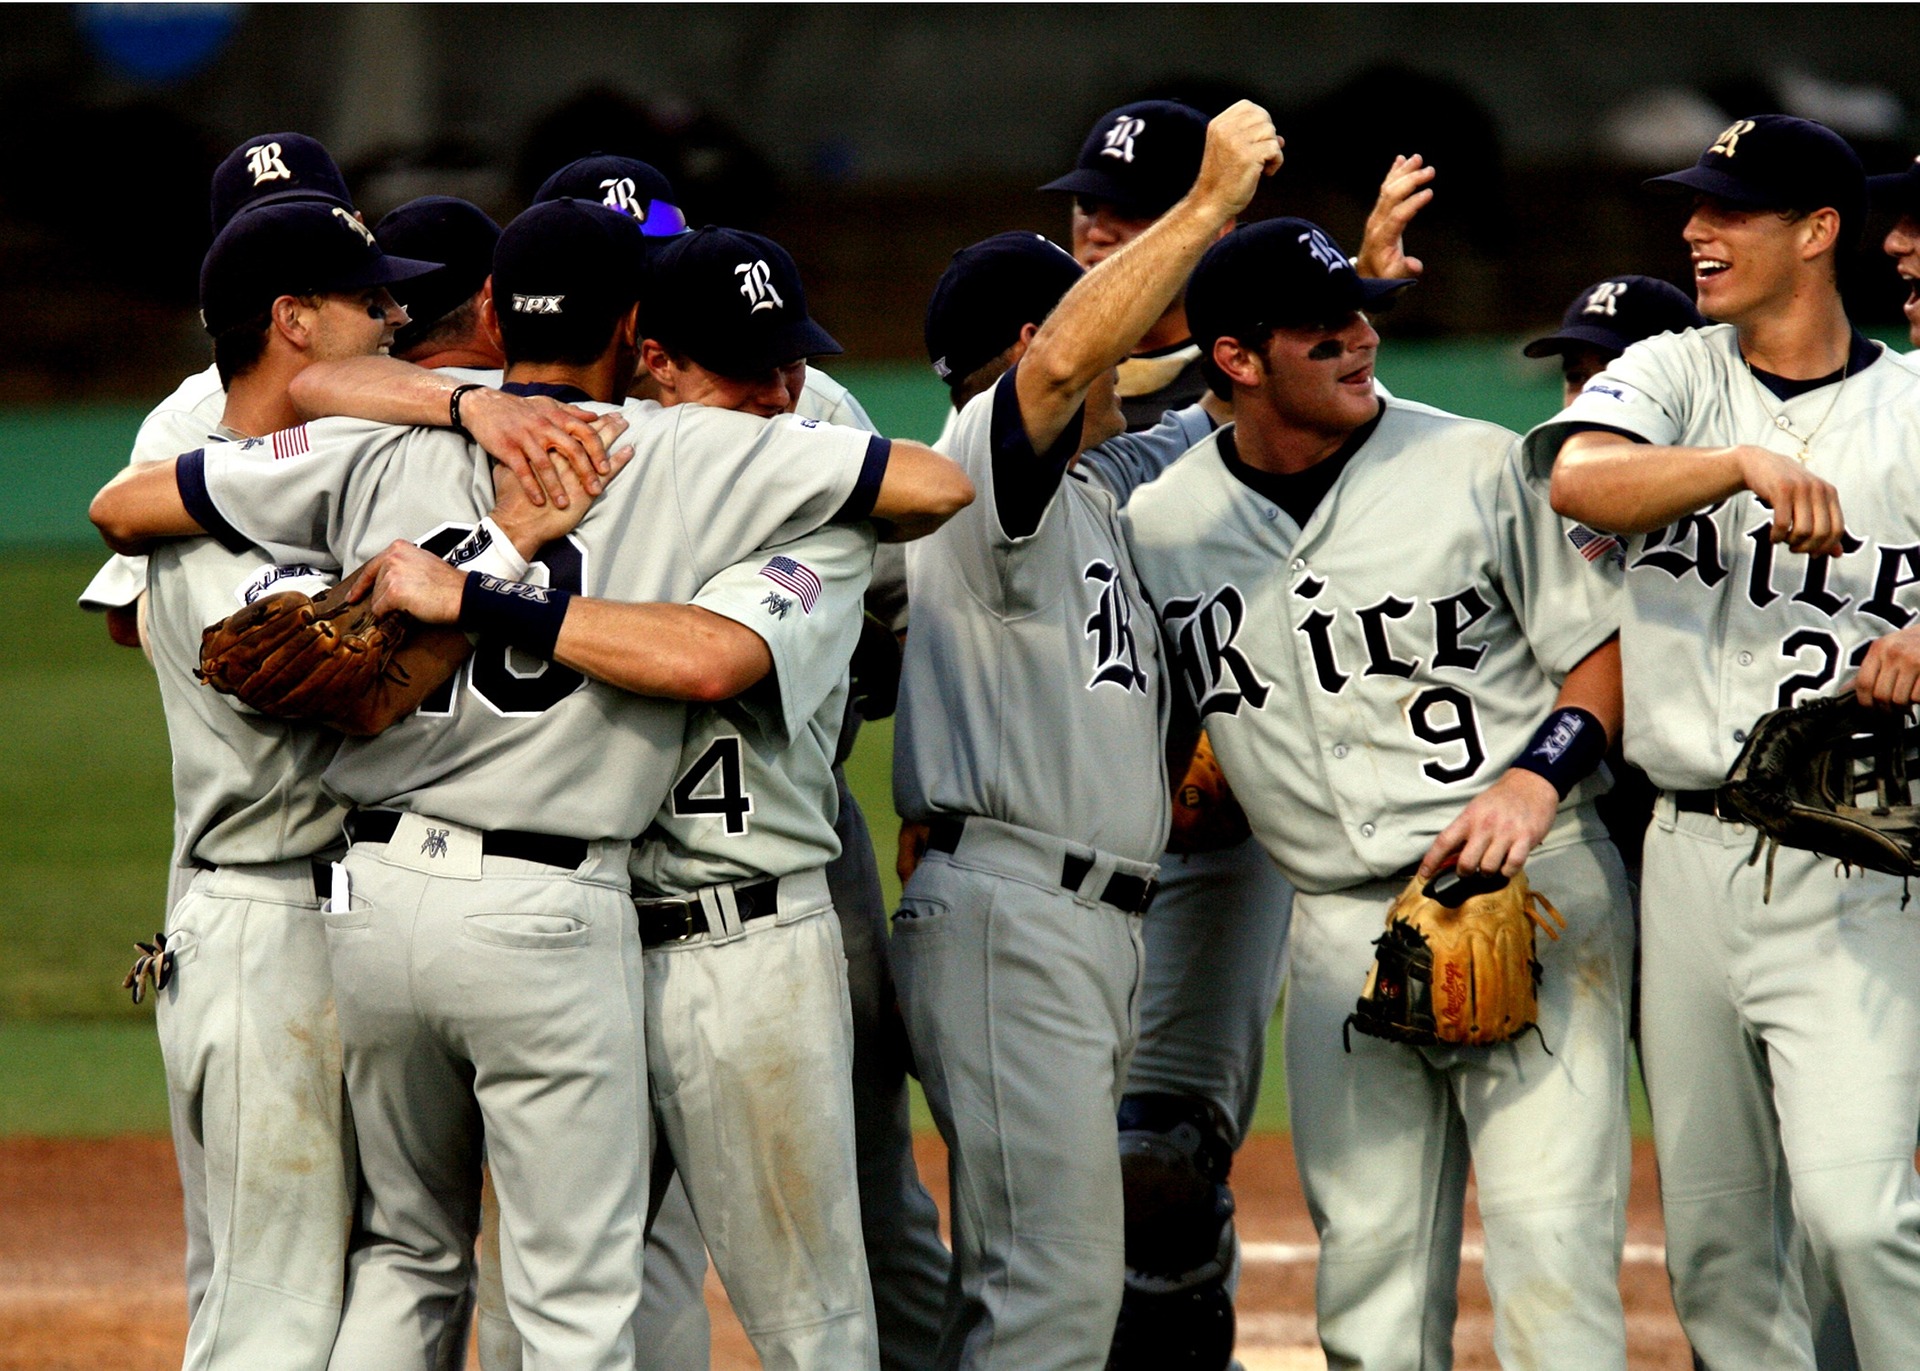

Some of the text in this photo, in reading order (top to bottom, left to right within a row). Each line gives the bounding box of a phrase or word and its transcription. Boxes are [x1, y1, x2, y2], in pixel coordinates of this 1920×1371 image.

[1101, 114, 1146, 163] R
[1708, 119, 1756, 158] R
[246, 141, 291, 186] R
[599, 177, 645, 221] R
[1299, 229, 1349, 274] R
[734, 259, 784, 315] R
[1582, 281, 1628, 317] R
[479, 572, 558, 604] TPX
[1162, 569, 1494, 719] Rice
[1404, 684, 1490, 786] 9
[1532, 711, 1585, 765] TPX
[671, 734, 755, 838] 4
